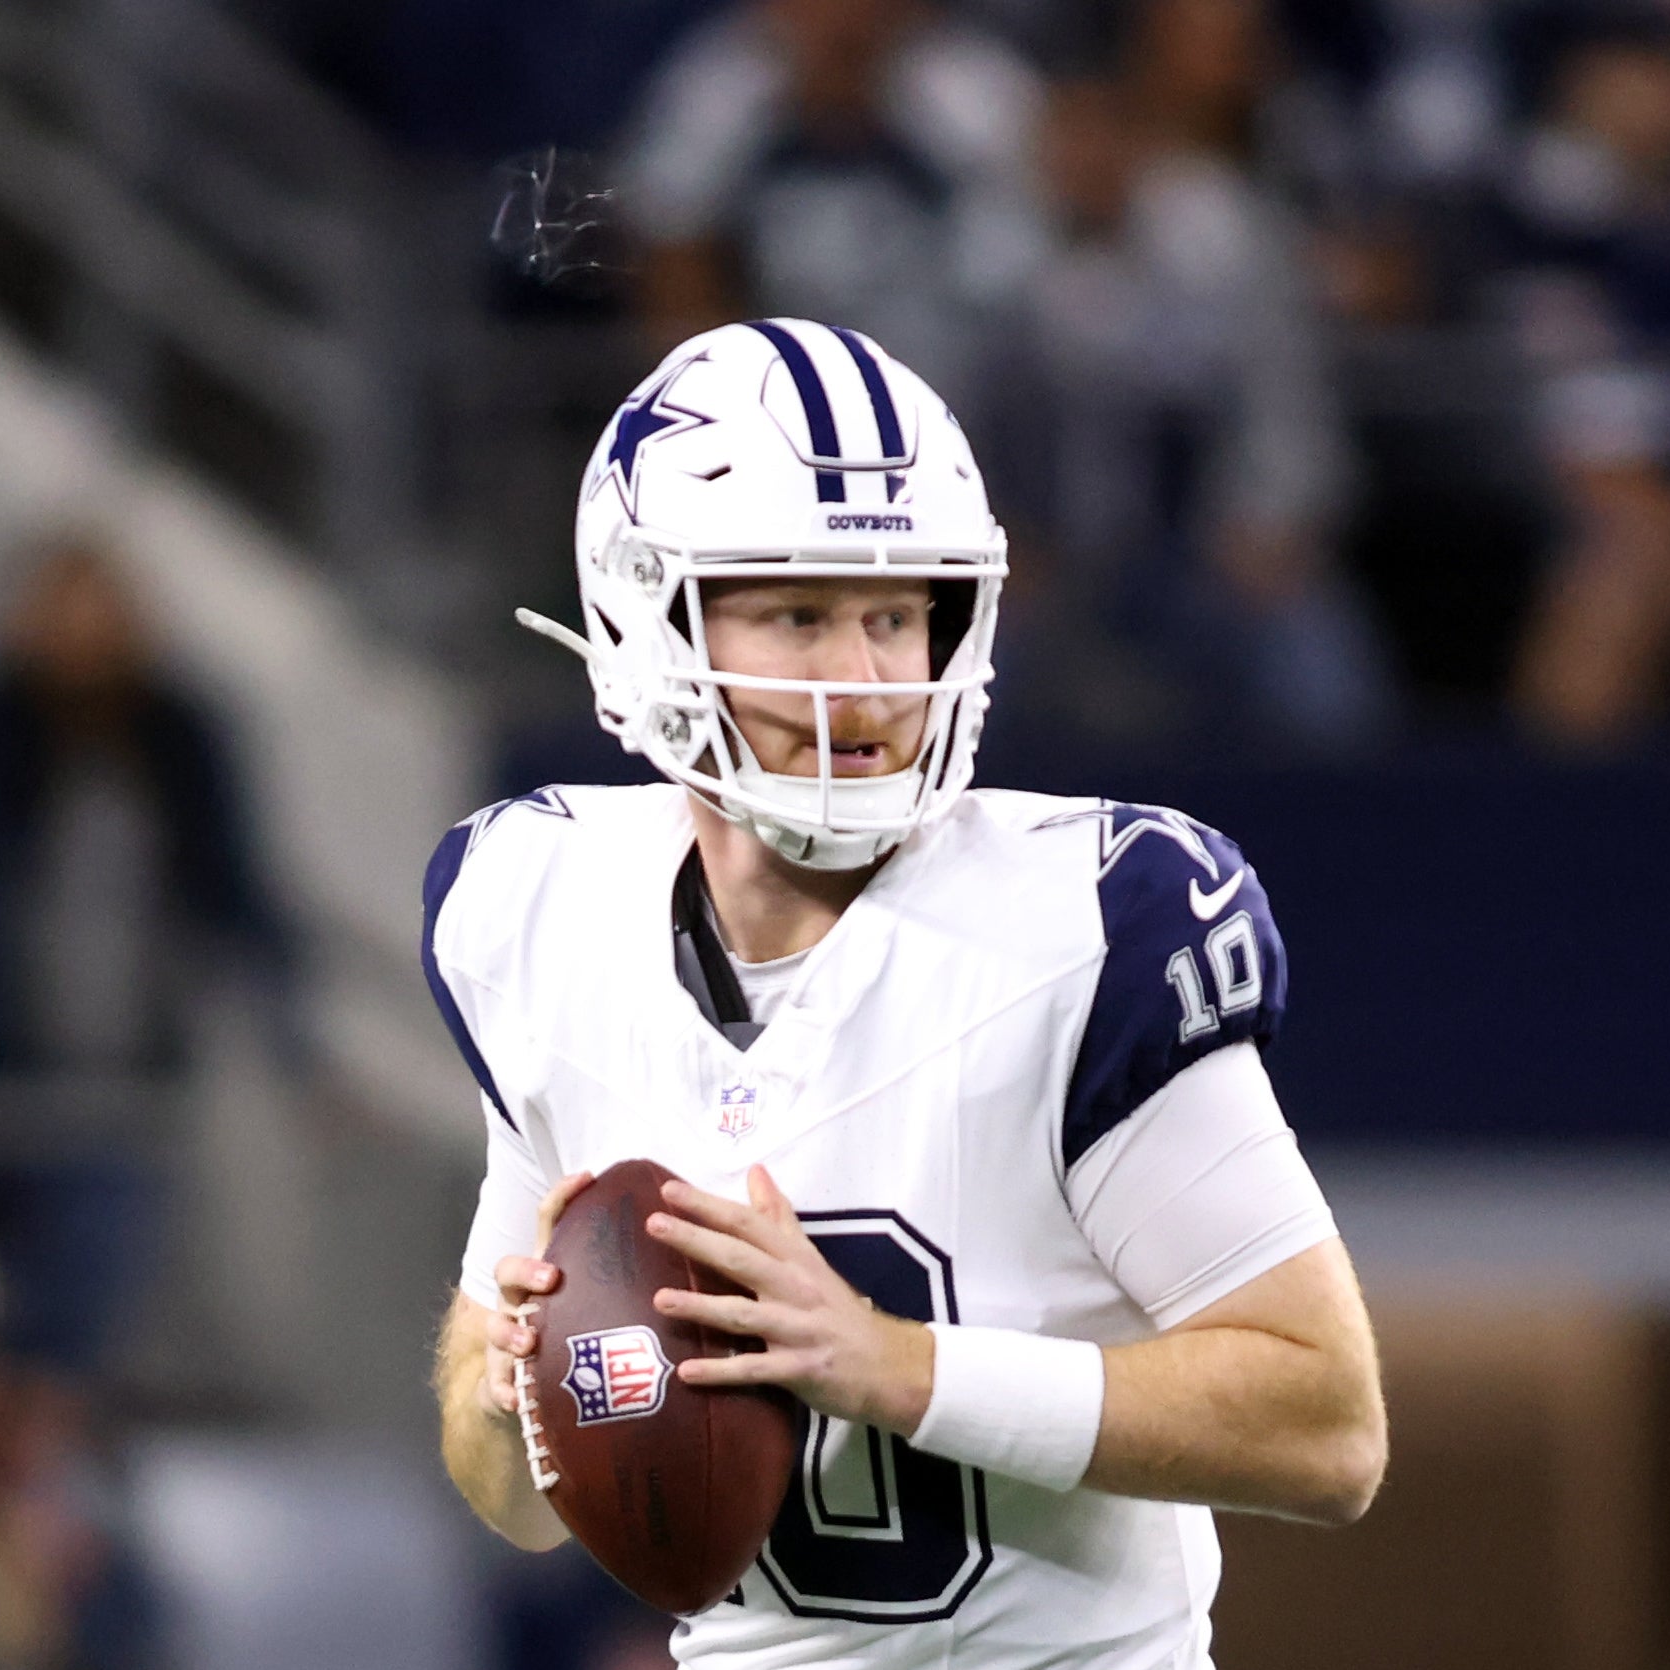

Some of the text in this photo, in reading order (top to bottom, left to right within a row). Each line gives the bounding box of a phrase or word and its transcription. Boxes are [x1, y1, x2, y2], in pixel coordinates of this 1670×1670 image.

[827, 515, 912, 531] COWBOYS
[1165, 909, 1262, 1044] 10
[720, 1107, 750, 1131] NFL
[607, 1338, 656, 1409] NFL
[722, 1208, 993, 1624] 0
